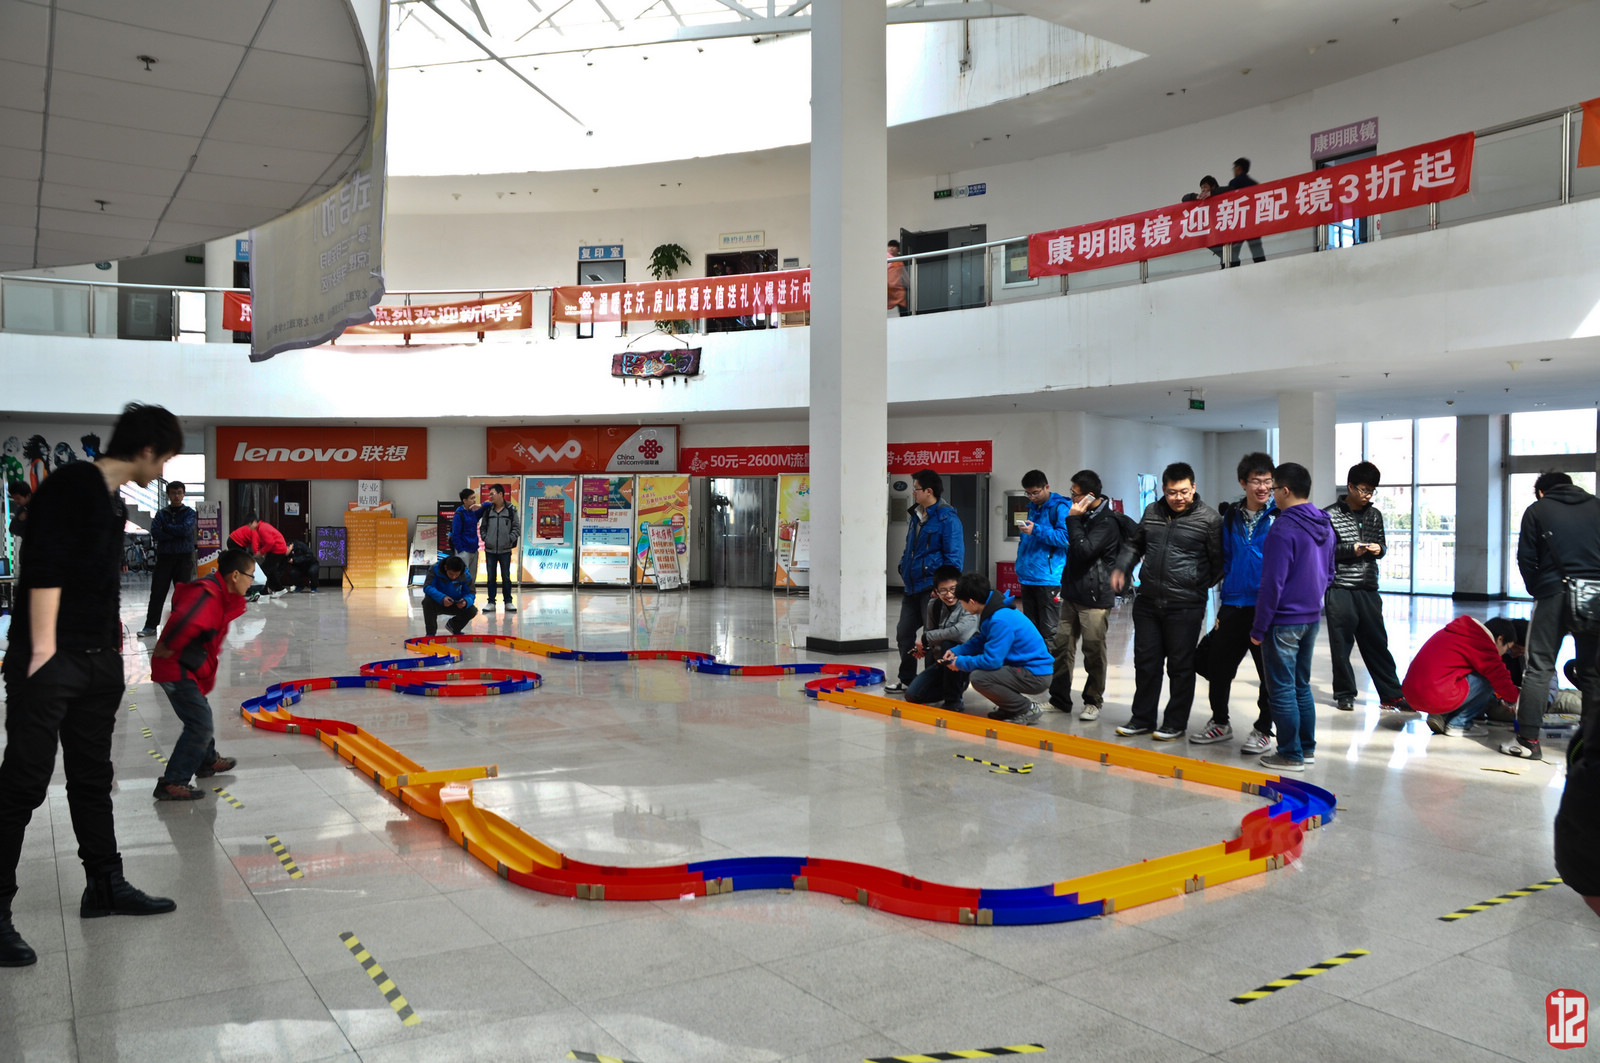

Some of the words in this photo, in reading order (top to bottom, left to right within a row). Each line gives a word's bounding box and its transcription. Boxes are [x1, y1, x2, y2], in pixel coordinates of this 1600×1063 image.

[1313, 121, 1376, 154] 康明眼镜
[1047, 148, 1456, 265] 康明眼镜迎新配镜3折起
[581, 246, 621, 259] 复印室
[233, 442, 357, 462] lenovo
[359, 445, 408, 462] 联想
